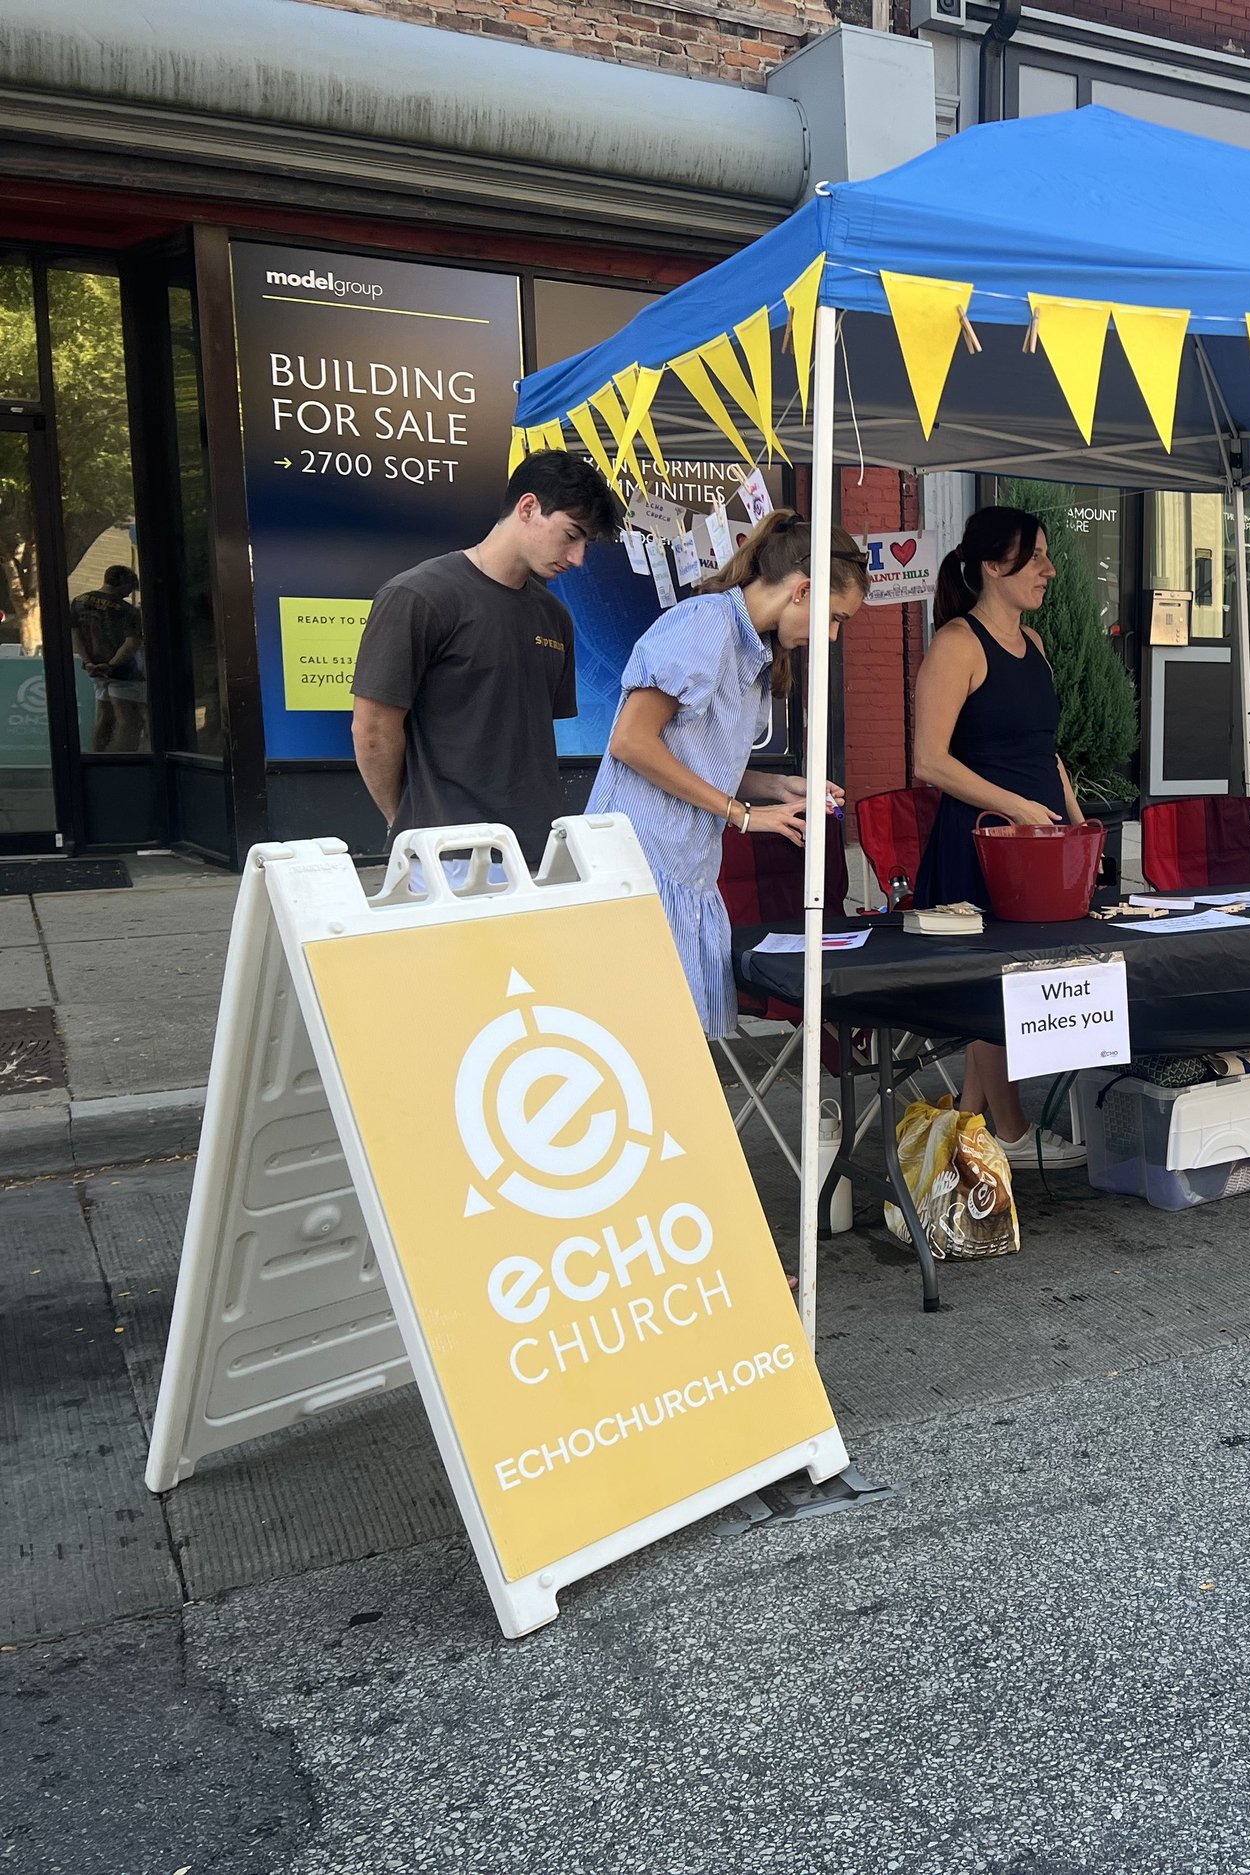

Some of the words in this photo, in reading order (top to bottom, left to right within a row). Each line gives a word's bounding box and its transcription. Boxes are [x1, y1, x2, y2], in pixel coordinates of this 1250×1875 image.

[266, 269, 383, 300] modelgroup
[269, 352, 476, 404] BUILDING
[272, 397, 360, 437] FOR
[374, 406, 468, 445] SALE
[300, 449, 372, 477] 2700
[384, 456, 458, 485] SQFT
[867, 542, 884, 571] I
[870, 572, 900, 583] ALNUT
[902, 569, 930, 580] HILLS
[297, 616, 335, 624] READY
[340, 617, 355, 625] TO
[300, 656, 328, 664] CALL
[1041, 980, 1091, 1001] What
[1021, 1013, 1076, 1035] makes
[1081, 1010, 1114, 1029] you
[509, 1268, 733, 1384] CHURCH
[494, 1343, 795, 1491] ECHOCHURCH.ORG
